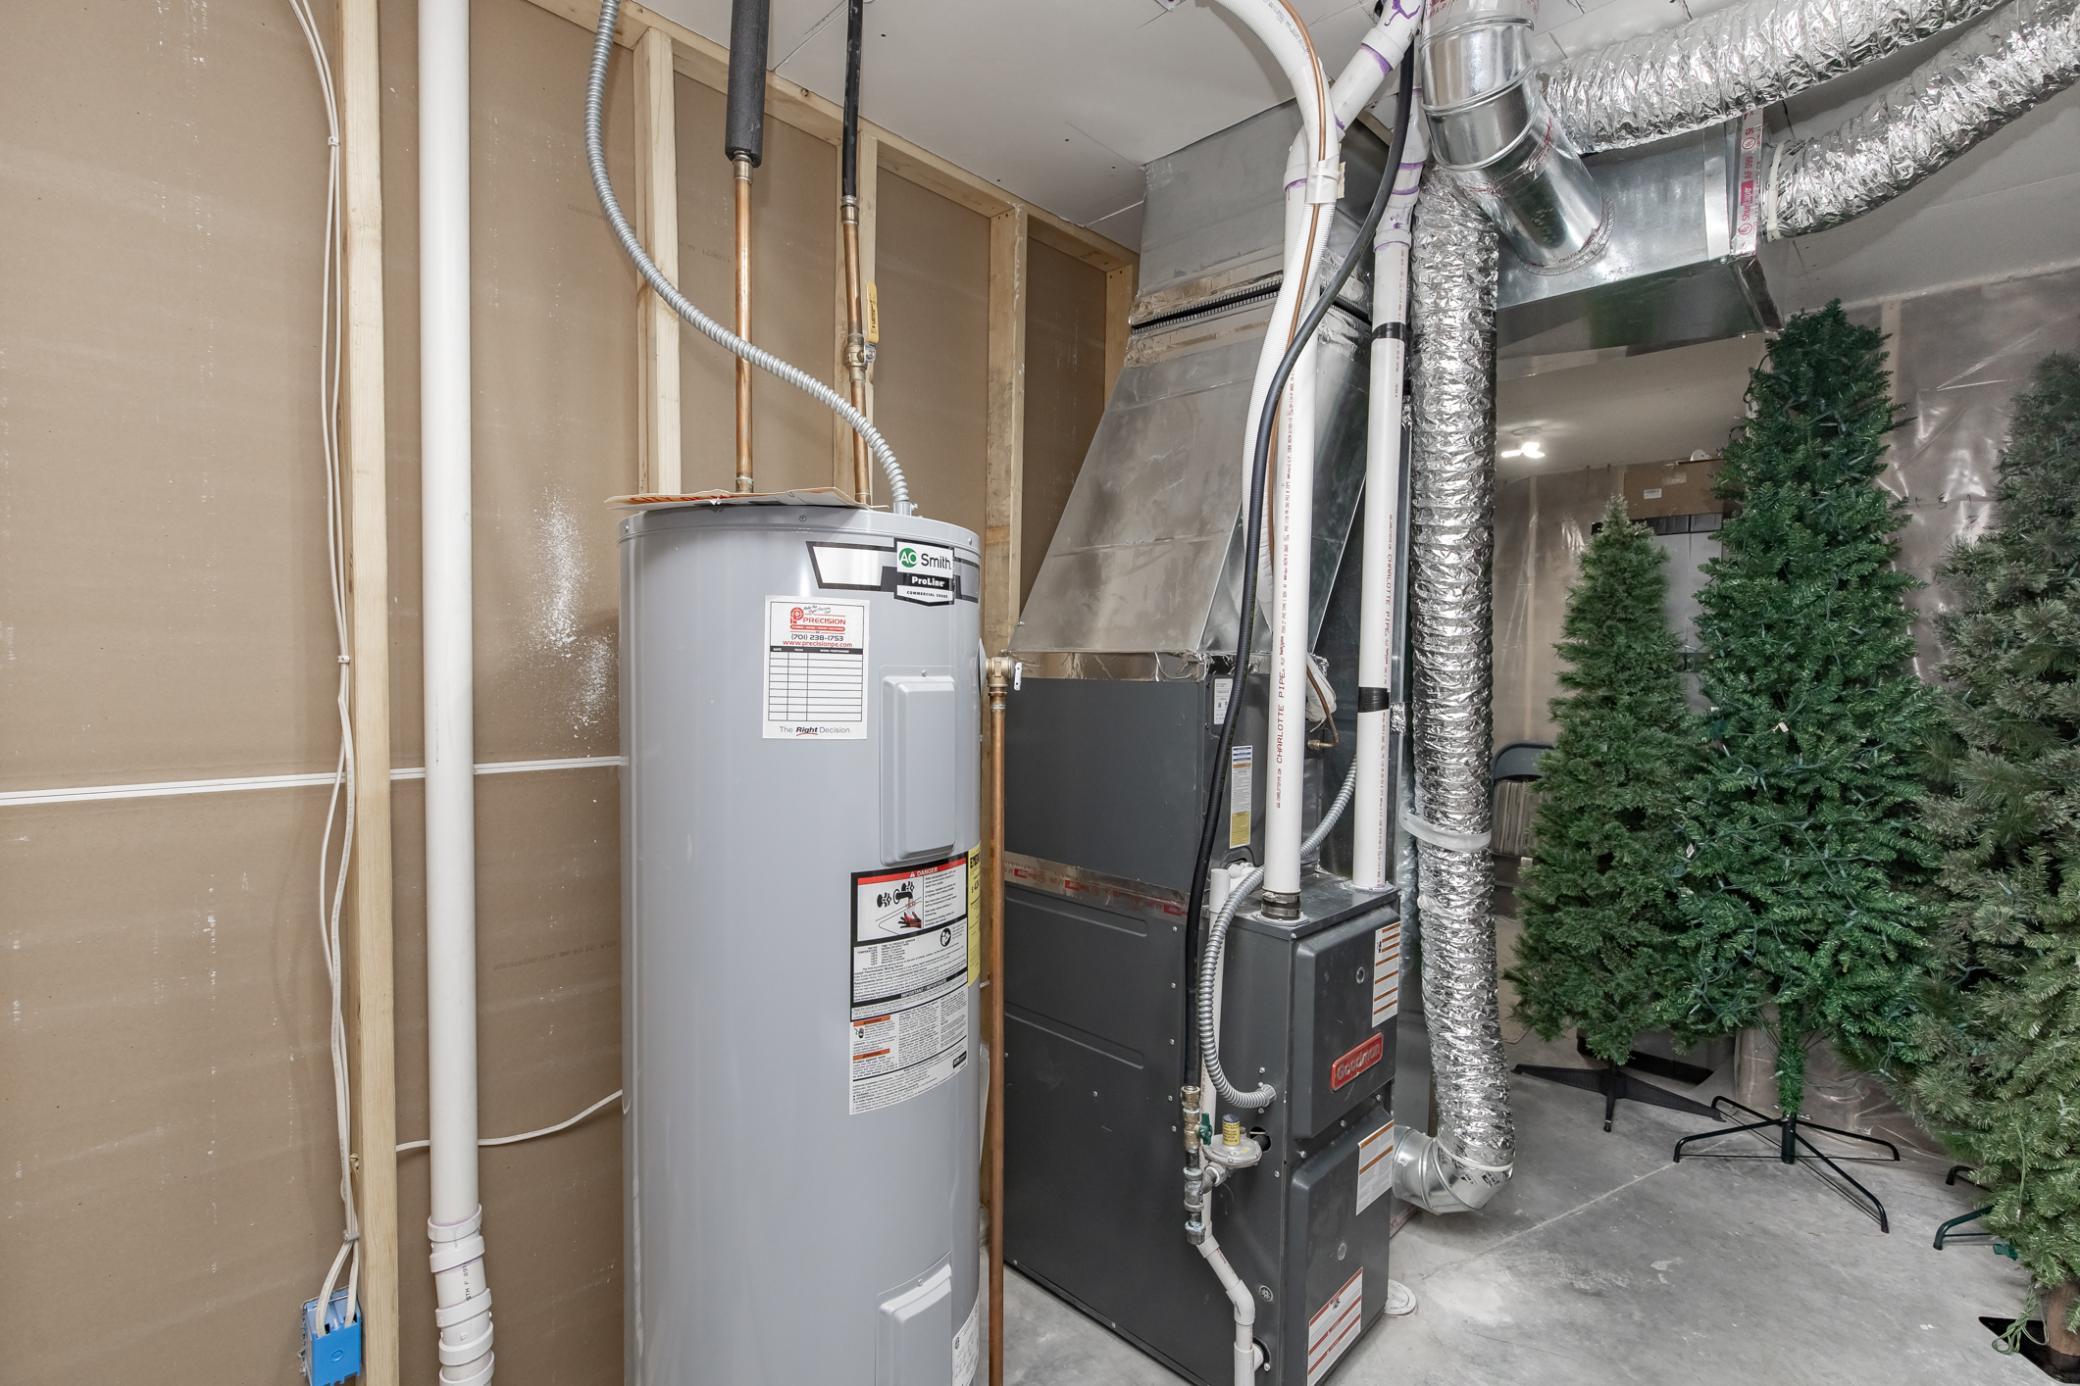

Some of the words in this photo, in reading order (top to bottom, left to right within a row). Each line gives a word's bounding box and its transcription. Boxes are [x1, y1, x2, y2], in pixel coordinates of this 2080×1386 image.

[921, 553, 951, 570] Smith
[911, 576, 945, 588] ProLine
[802, 617, 847, 625] PRECISION
[1278, 671, 1286, 698] PIPE
[795, 726, 818, 734] Right
[1276, 705, 1285, 764] CHARLOTTE
[1336, 1044, 1380, 1079] Goodman
